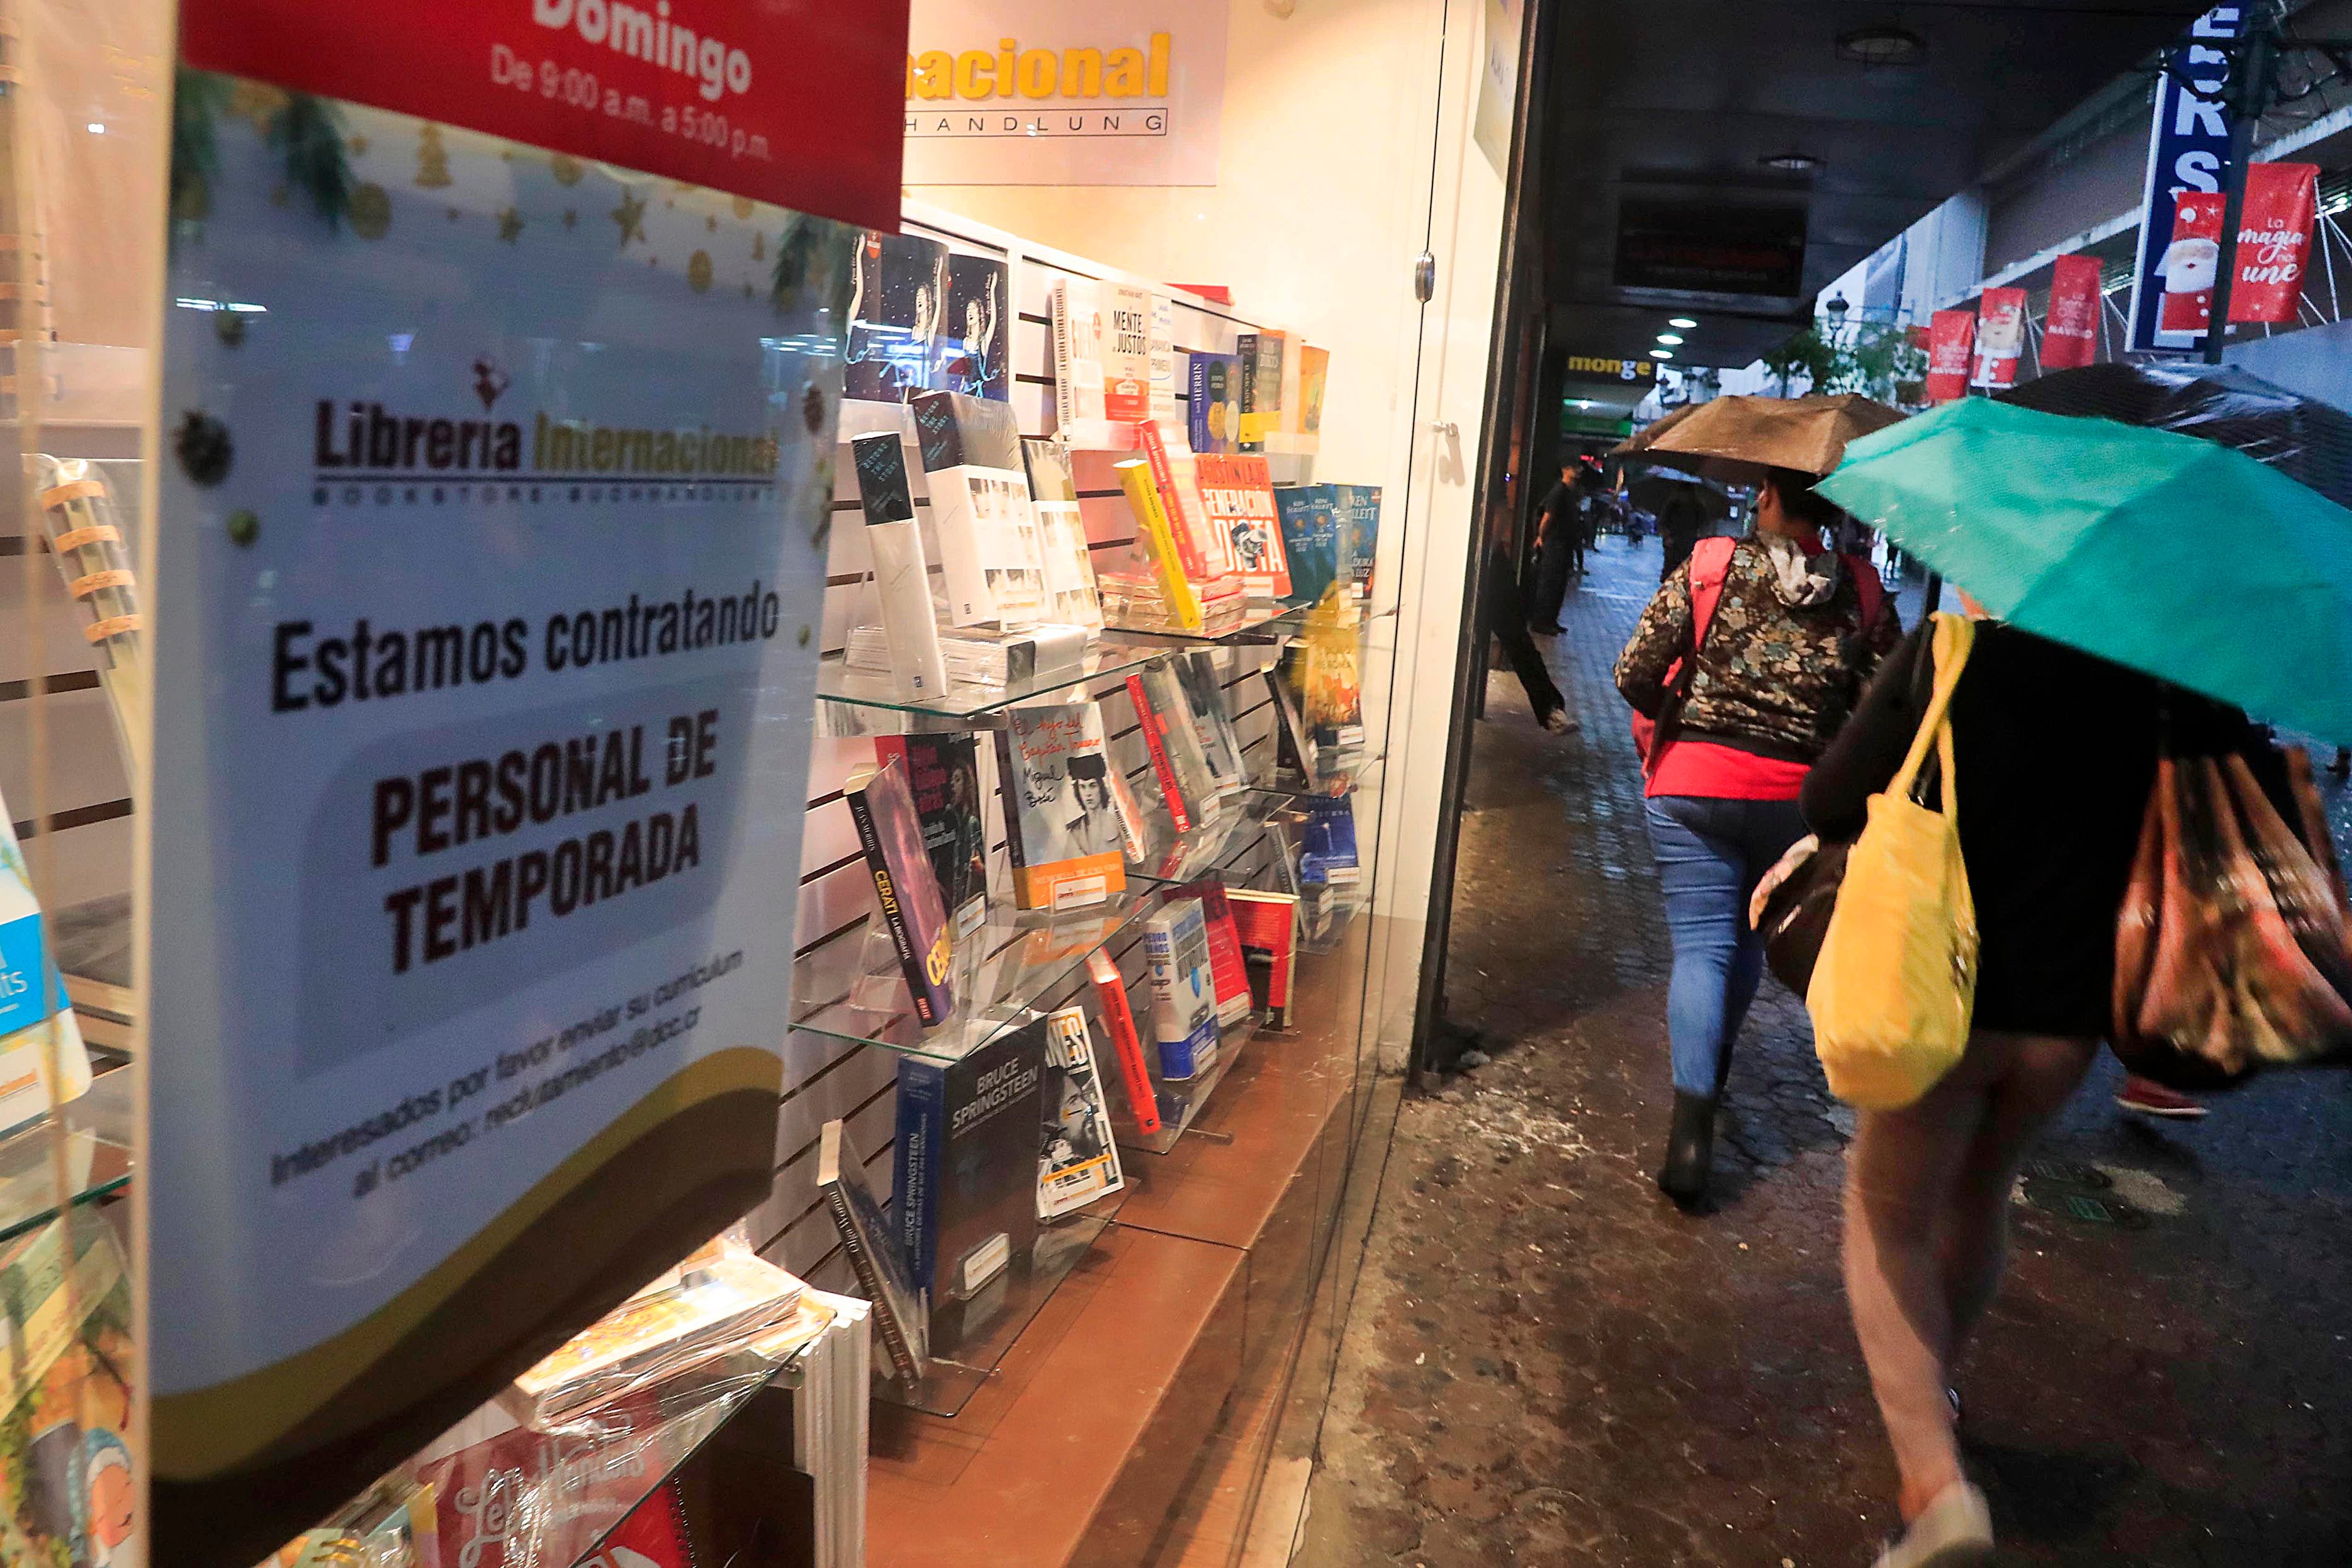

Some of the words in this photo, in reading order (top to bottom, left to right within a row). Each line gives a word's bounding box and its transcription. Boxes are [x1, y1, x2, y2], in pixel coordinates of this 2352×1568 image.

[533, 0, 751, 101] Domingo
[907, 31, 1170, 101] acional
[491, 44, 533, 91] De
[539, 61, 599, 110] 9:00
[661, 107, 678, 133] a
[682, 106, 728, 147] 5:00
[2237, 228, 2304, 264] magia
[2242, 263, 2300, 284] une
[1113, 310, 1142, 333] MENTE
[1117, 333, 1147, 356] JUSTOS
[1568, 357, 1651, 379] monge
[271, 617, 527, 712] Estamos
[544, 580, 781, 673] contratando
[372, 722, 652, 869] PERSONAL
[667, 708, 719, 790] DE
[385, 803, 700, 975] TEMPORADA
[872, 869, 899, 916] CERATI
[271, 1087, 442, 1187] Interesados
[447, 1066, 490, 1111] por
[495, 1037, 554, 1081] favor
[558, 1005, 622, 1049] enviar
[626, 993, 652, 1022] su
[952, 1065, 1038, 1130] SPRINGSTEEN
[977, 1057, 1019, 1095] BRUCE
[828, 1190, 850, 1229] Wornat
[845, 1228, 860, 1253] Olga
